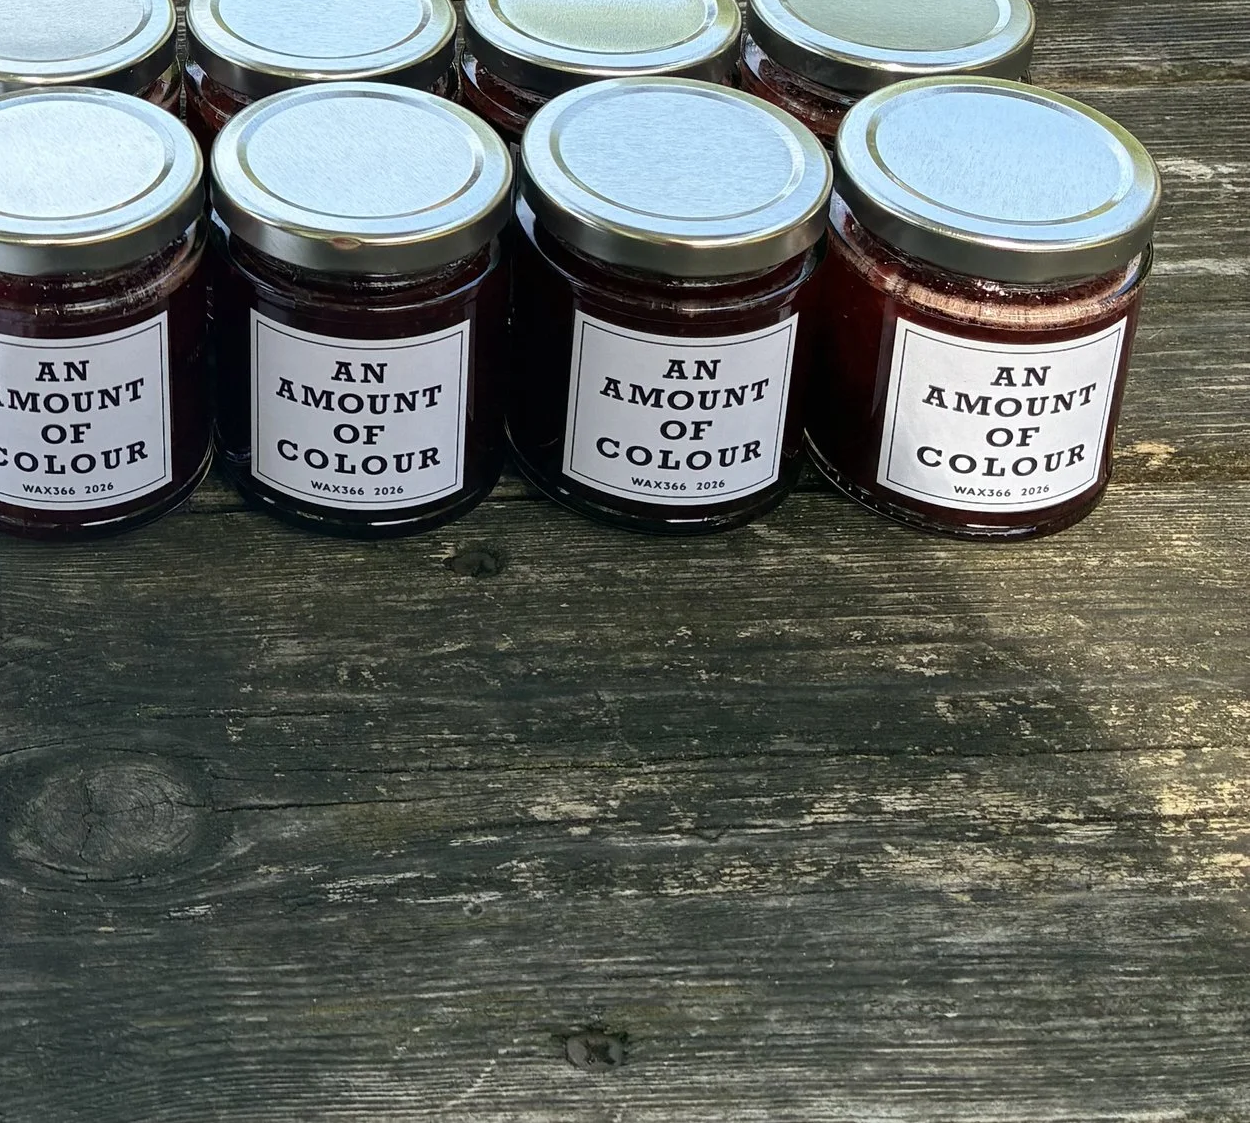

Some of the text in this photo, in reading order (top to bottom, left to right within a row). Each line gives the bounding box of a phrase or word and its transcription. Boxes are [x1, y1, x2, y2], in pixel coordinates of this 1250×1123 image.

[34, 359, 90, 383] AN
[330, 360, 388, 384] AN
[662, 358, 722, 381] AN
[989, 365, 1052, 388] AN
[275, 376, 442, 415] AMOUNT
[599, 376, 770, 411] AMOUNT
[921, 382, 1097, 418] AMOUNT
[40, 422, 92, 445] OF
[333, 423, 385, 445] OF
[659, 420, 713, 441] OF
[985, 426, 1041, 448] OF
[276, 439, 441, 476] COLOUR
[595, 436, 762, 471] COLOUR
[916, 443, 1085, 477] COLOUR
[22, 481, 114, 496] WAX366 2026
[310, 479, 404, 496] WAX366 2026
[631, 476, 726, 491] WAX366 2026
[953, 484, 1050, 498] WAX366 2026
